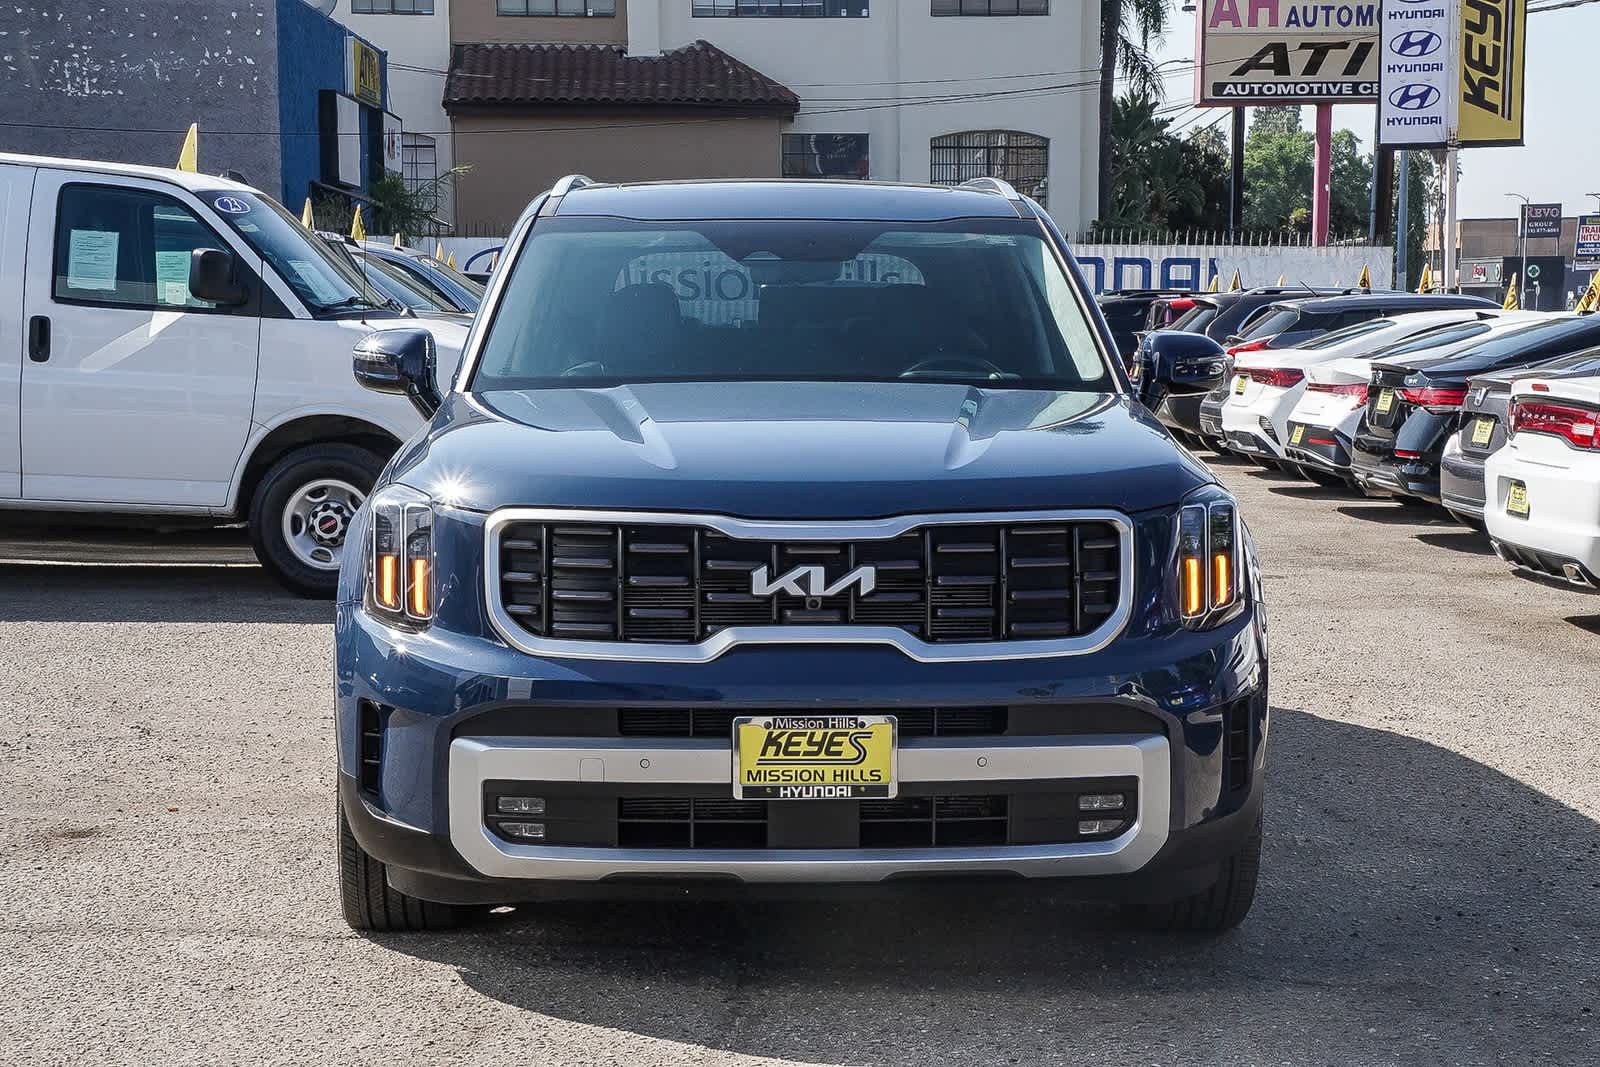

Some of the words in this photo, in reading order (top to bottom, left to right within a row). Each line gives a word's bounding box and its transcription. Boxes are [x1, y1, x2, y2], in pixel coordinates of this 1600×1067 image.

[1285, 4, 1380, 28] AUTOM
[1388, 8, 1445, 20] HYUNDAI
[1463, 0, 1502, 114] KEY
[1387, 62, 1444, 73] HYUNDAI
[1222, 83, 1353, 96] AUTOMOTIVE
[1386, 115, 1442, 126] HYUNDAI
[752, 565, 876, 597] KIA
[775, 717, 824, 729] Mission
[828, 717, 856, 729] Hills
[756, 731, 874, 766] KEYES
[746, 769, 825, 782] MISSION
[833, 769, 882, 782] HILLS
[779, 786, 852, 798] HYUNDAI
